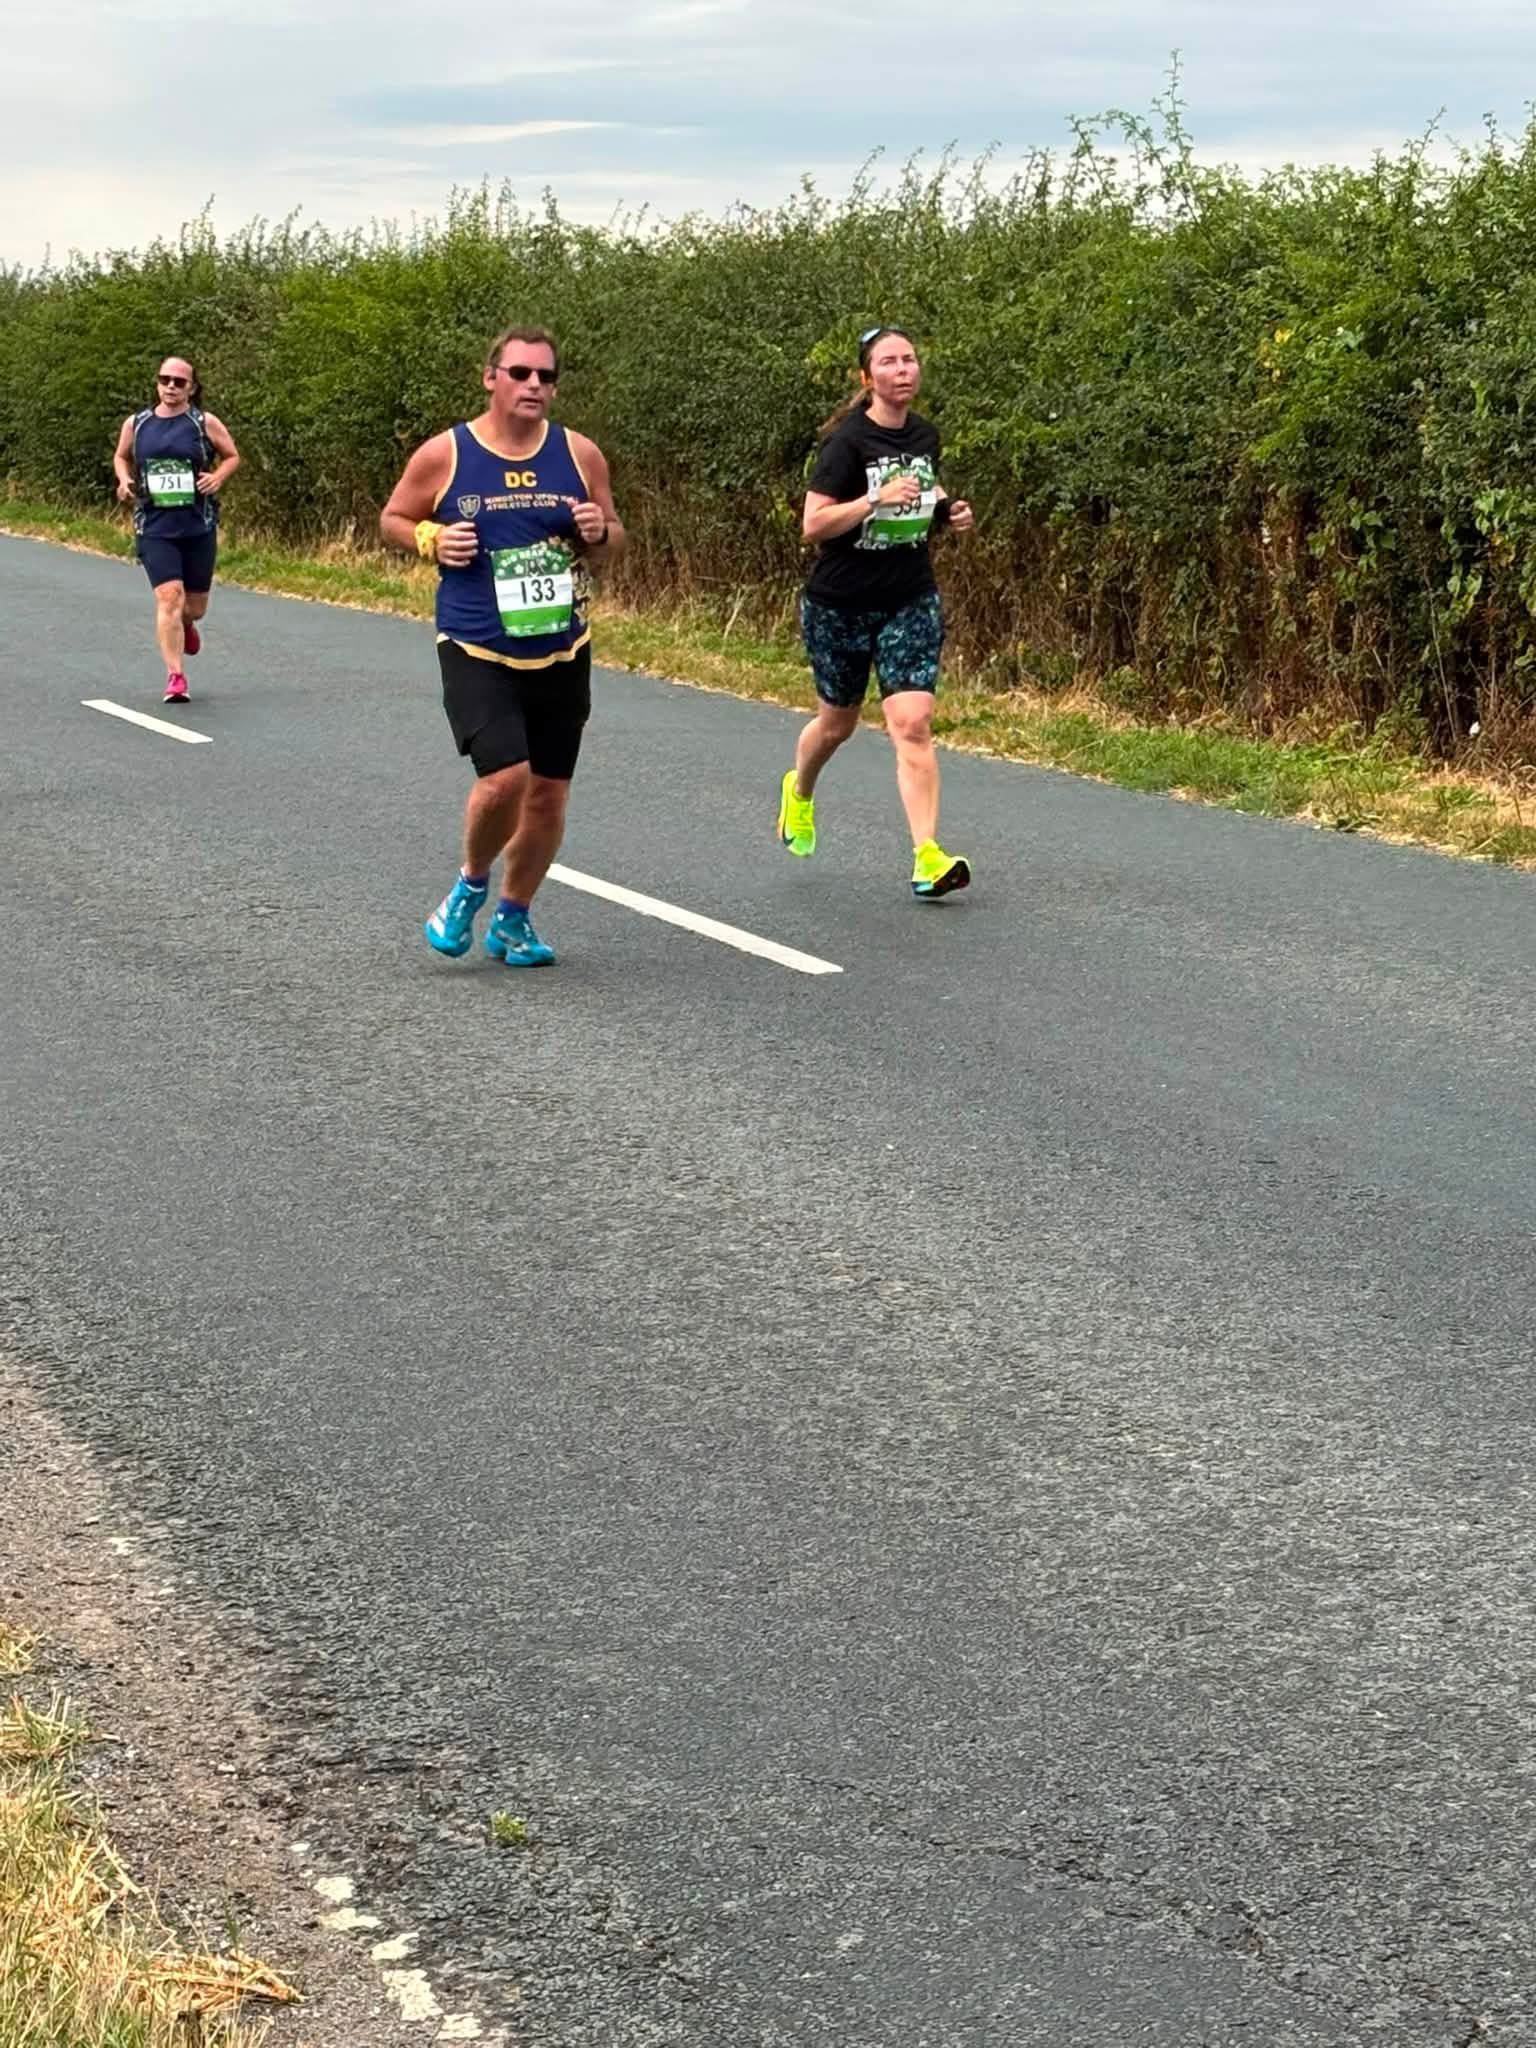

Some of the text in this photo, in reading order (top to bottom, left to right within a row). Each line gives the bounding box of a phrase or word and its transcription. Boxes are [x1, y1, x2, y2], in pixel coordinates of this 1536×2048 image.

[160, 476, 182, 490] 751
[504, 471, 537, 489] DC
[486, 500, 557, 512] ATHLETIC CLUB
[520, 577, 556, 605] 133
